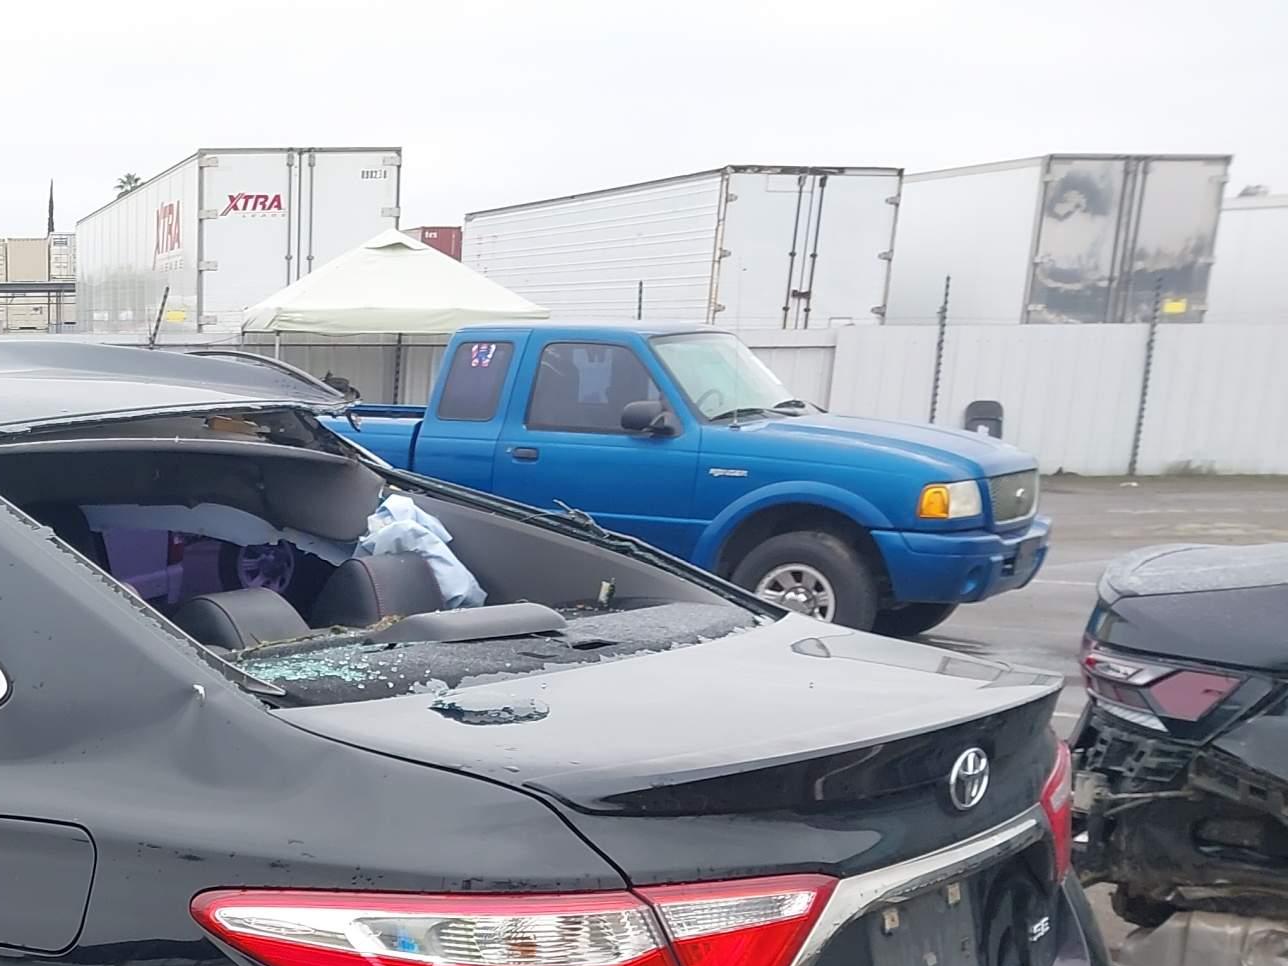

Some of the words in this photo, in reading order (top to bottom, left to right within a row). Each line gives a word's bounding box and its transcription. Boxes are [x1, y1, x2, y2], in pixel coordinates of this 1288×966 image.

[220, 193, 282, 216] XTRA
[152, 200, 181, 271] XTRA
[1029, 916, 1050, 941] SE
